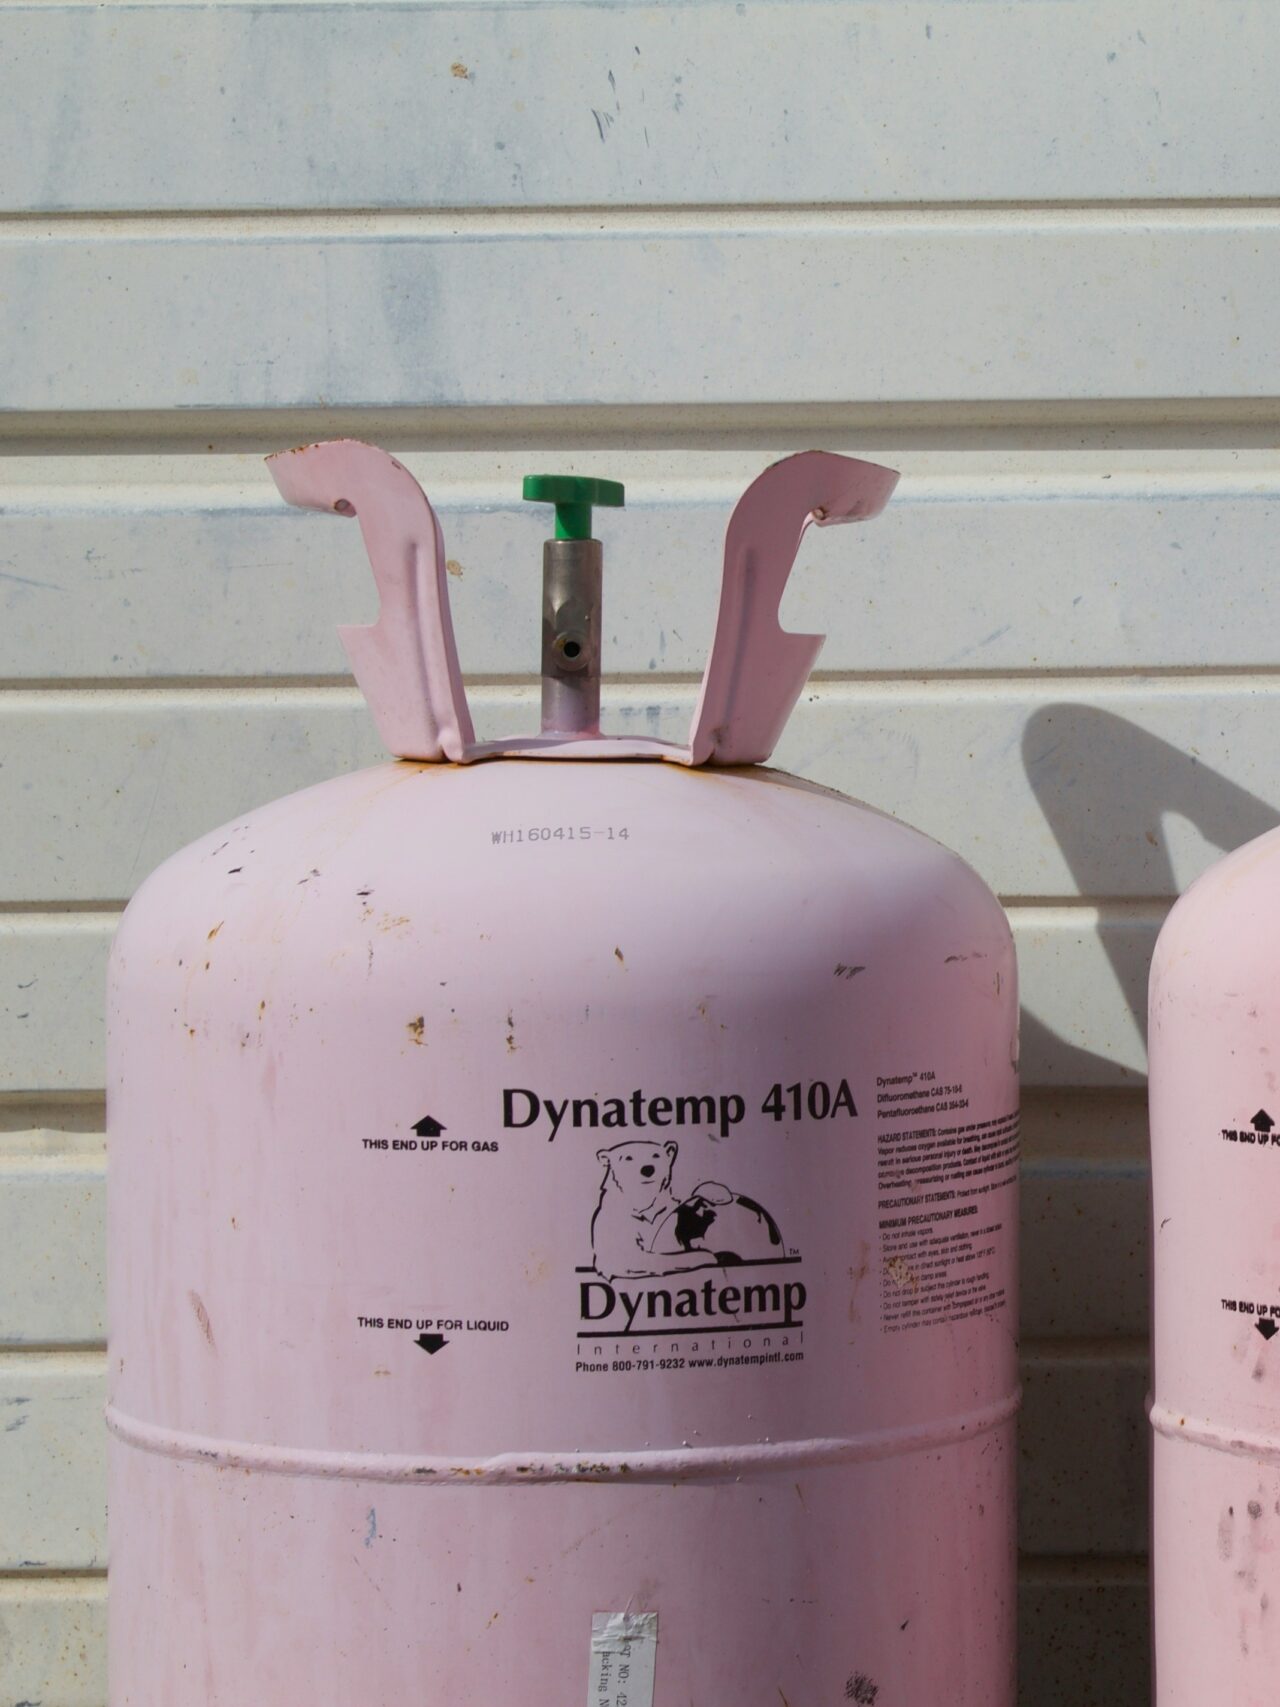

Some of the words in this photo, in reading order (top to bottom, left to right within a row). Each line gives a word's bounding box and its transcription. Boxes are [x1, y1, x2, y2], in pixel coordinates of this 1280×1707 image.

[492, 826, 630, 845] WH160415-14
[919, 1071, 936, 1082] 410A
[930, 1087, 943, 1096] CAS
[502, 1089, 746, 1142] Dynatemp
[761, 1079, 859, 1122] 410A
[936, 1102, 948, 1112] CAS
[878, 1132, 901, 1143] HAZARD
[1221, 1129, 1238, 1142] THIS
[1239, 1131, 1256, 1144] END
[1257, 1132, 1269, 1145] UP
[362, 1138, 389, 1150] THIS
[392, 1140, 417, 1151] END
[421, 1141, 438, 1151] UP
[442, 1141, 468, 1152] FOR
[471, 1141, 498, 1152] GAS
[878, 1195, 923, 1209] PRECAUTIONARY
[908, 1210, 952, 1225] PRECAUTIONARY
[882, 1232, 890, 1240] Do
[882, 1289, 891, 1298] Do
[580, 1279, 807, 1333] Dynatemp
[882, 1301, 891, 1309] Do
[1221, 1299, 1237, 1311] THIS
[1239, 1301, 1255, 1314] END
[1256, 1304, 1268, 1316] UP
[357, 1317, 384, 1329] THIS
[387, 1318, 412, 1329] END
[416, 1319, 433, 1330] UP
[437, 1320, 462, 1330] FOR
[466, 1320, 509, 1332] LIQUID
[577, 1331, 804, 1357] International
[575, 1361, 609, 1372] Phone
[612, 1358, 685, 1372] 800-791-9232
[688, 1351, 804, 1369] www.dynatempintl.com
[598, 1651, 612, 1692] acking
[618, 1664, 630, 1684] NO:
